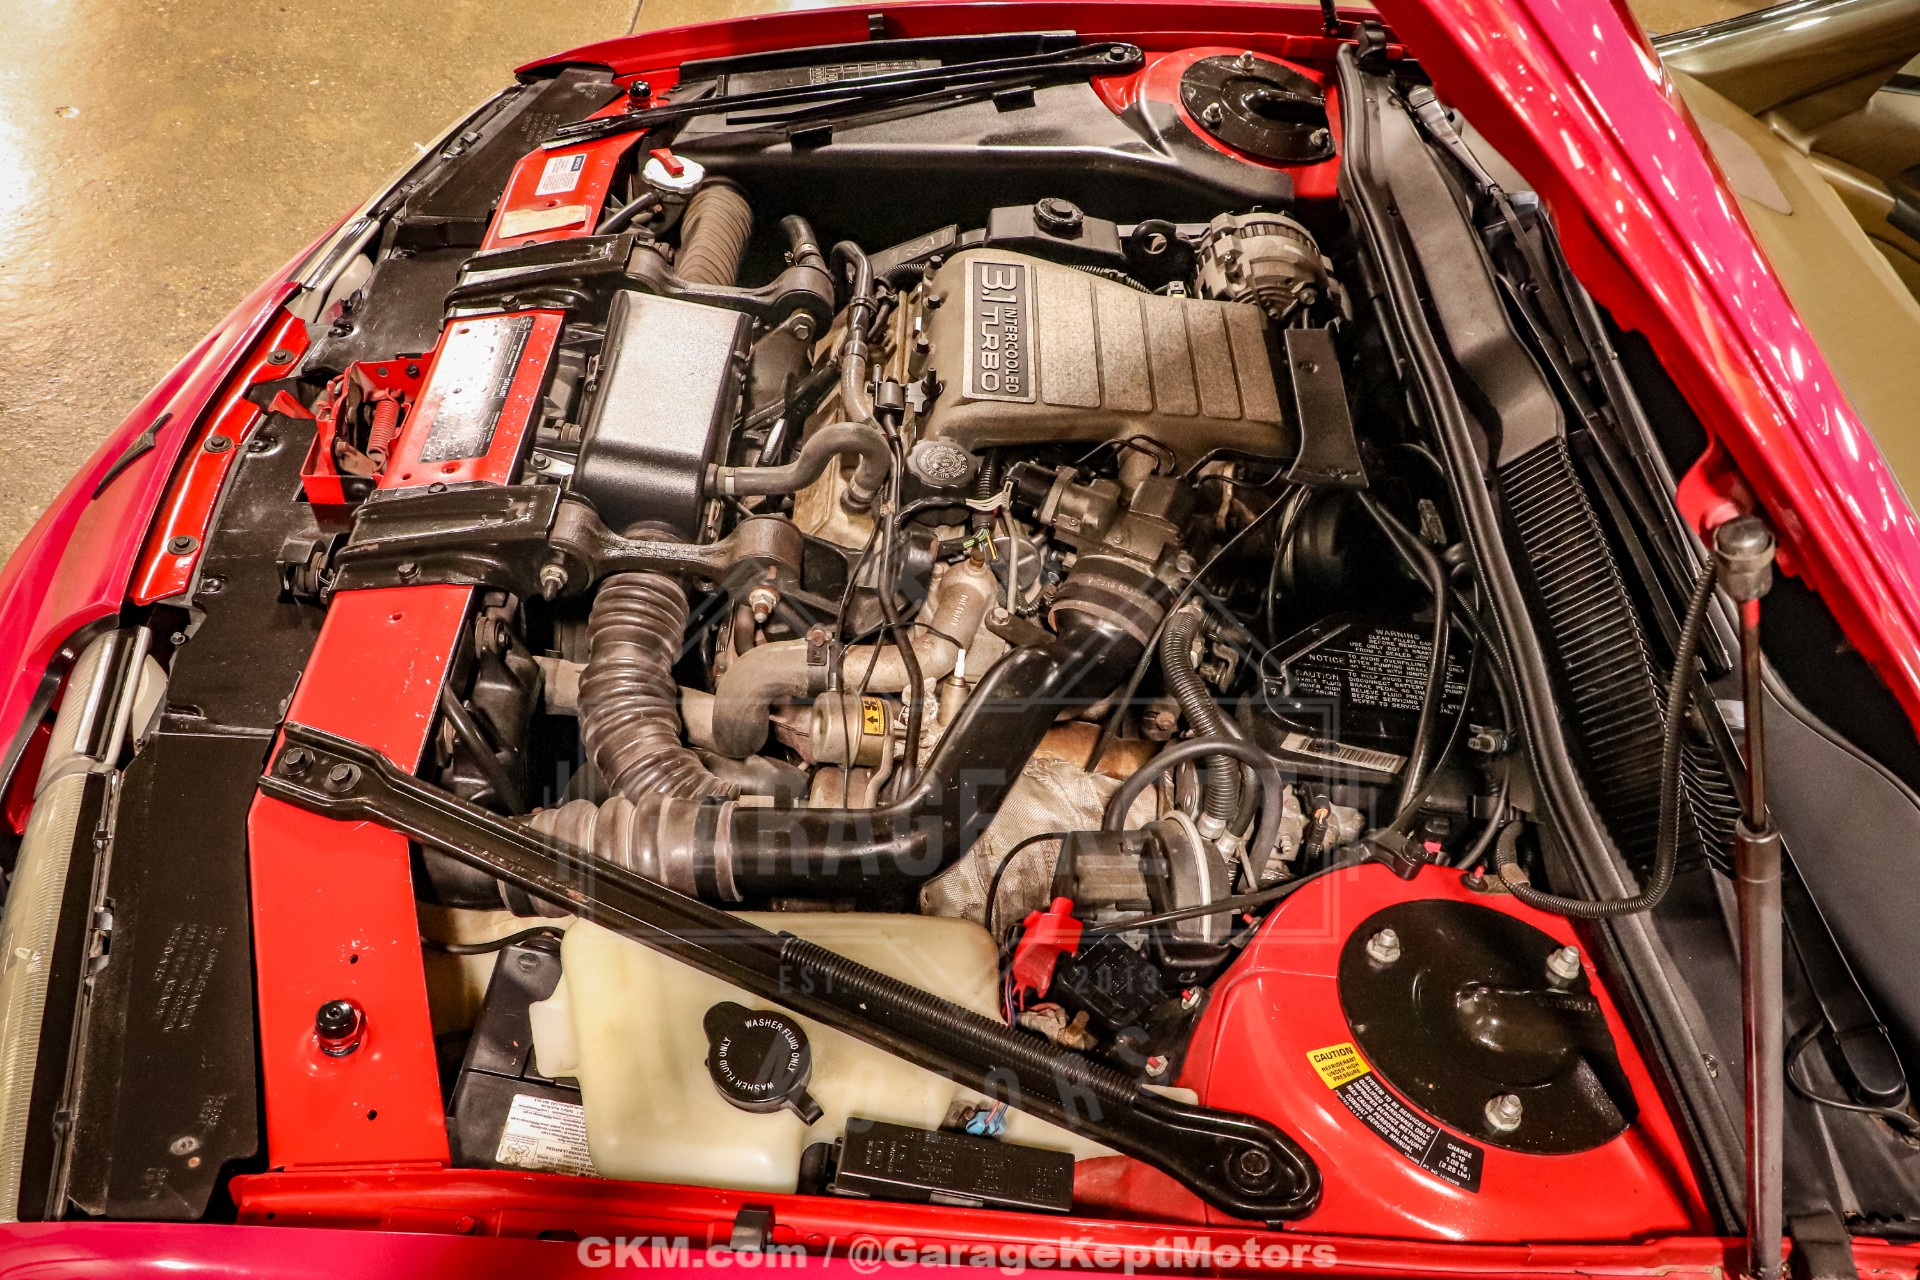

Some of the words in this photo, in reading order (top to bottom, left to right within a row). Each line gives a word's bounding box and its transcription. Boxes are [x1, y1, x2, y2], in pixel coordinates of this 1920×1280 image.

[981, 265, 1018, 303] 3.1
[981, 306, 1000, 392] TURBO
[1004, 306, 1020, 393] INTERCOOLED
[1375, 628, 1420, 640] WARNING
[1309, 654, 1345, 664] NOTICE
[1296, 669, 1339, 680] CAUTION
[745, 1018, 783, 1032] WASHER
[719, 1037, 732, 1057] ONLY
[782, 1028, 799, 1050] FLUID
[787, 1053, 800, 1073] ONLY
[1313, 1046, 1354, 1063] CAUTION
[720, 1060, 736, 1081] FLUID
[1327, 1066, 1345, 1077] UNDER
[1346, 1062, 1360, 1072] HIGH
[1332, 1069, 1361, 1082] PRESSURE
[735, 1079, 775, 1092] WASHER
[1346, 1084, 1359, 1097] MAY
[1356, 1095, 1374, 1113] CAUSE
[1373, 1111, 1400, 1137] PERSONAL
[1352, 1082, 1378, 1108] IMPROPER
[1376, 1105, 1400, 1126] SERVICE
[1399, 1124, 1427, 1146] METHODS
[1358, 1079, 1384, 1104] QUALIFIED
[1382, 1102, 1414, 1130] PERSONNEL
[1364, 1075, 1385, 1096] SYSTEM
[1384, 1094, 1392, 1103] TO
[1391, 1101, 1400, 1110] BE
[1399, 1108, 1427, 1129] SERVICED
[1426, 1127, 1435, 1135] BY
[1345, 1093, 1369, 1116] CONSULT
[1366, 1115, 1390, 1136] SERVICE
[1389, 1133, 1413, 1154] MANUAL
[1447, 1143, 1473, 1159] CHARGE
[1446, 1156, 1460, 1167] 1.02
